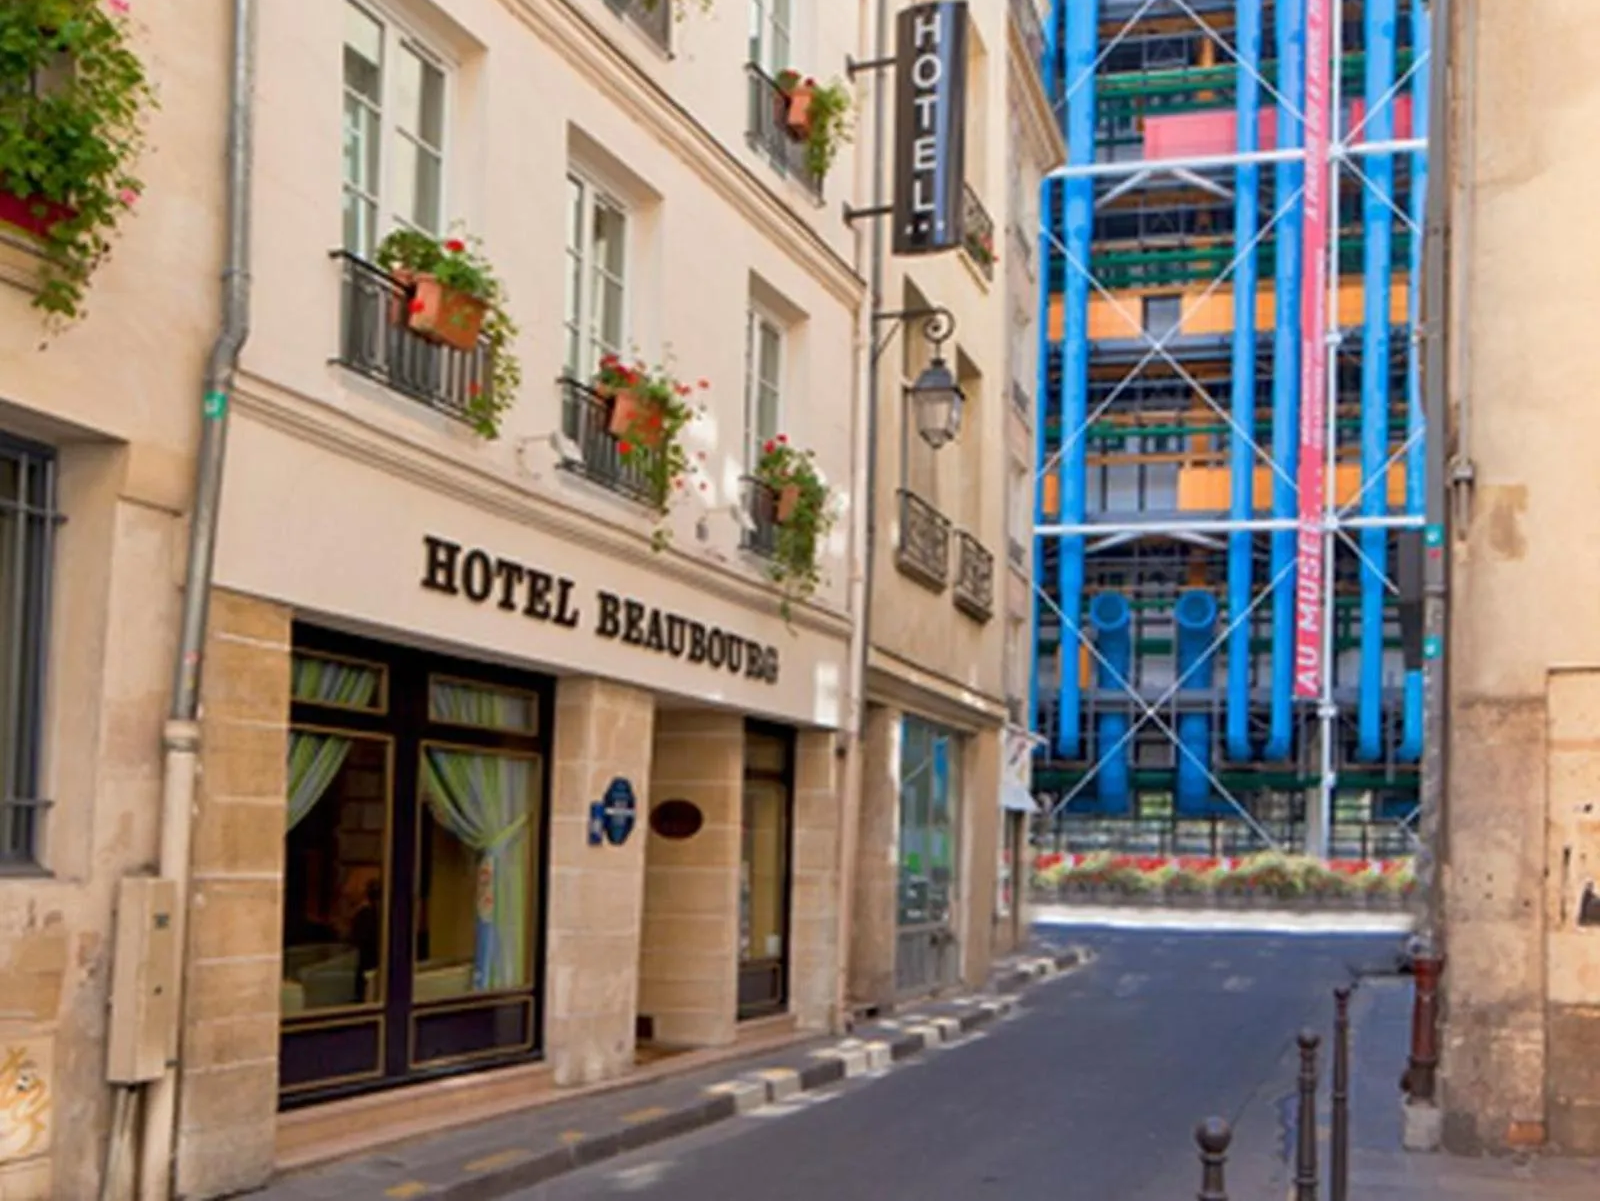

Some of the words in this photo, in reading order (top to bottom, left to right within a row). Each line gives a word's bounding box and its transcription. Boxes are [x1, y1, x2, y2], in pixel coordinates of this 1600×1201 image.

[912, 14, 942, 213] HOTEL
[421, 535, 580, 629] HOTEL
[596, 590, 780, 685] BEAUBOURG
[1298, 646, 1320, 692] AU
